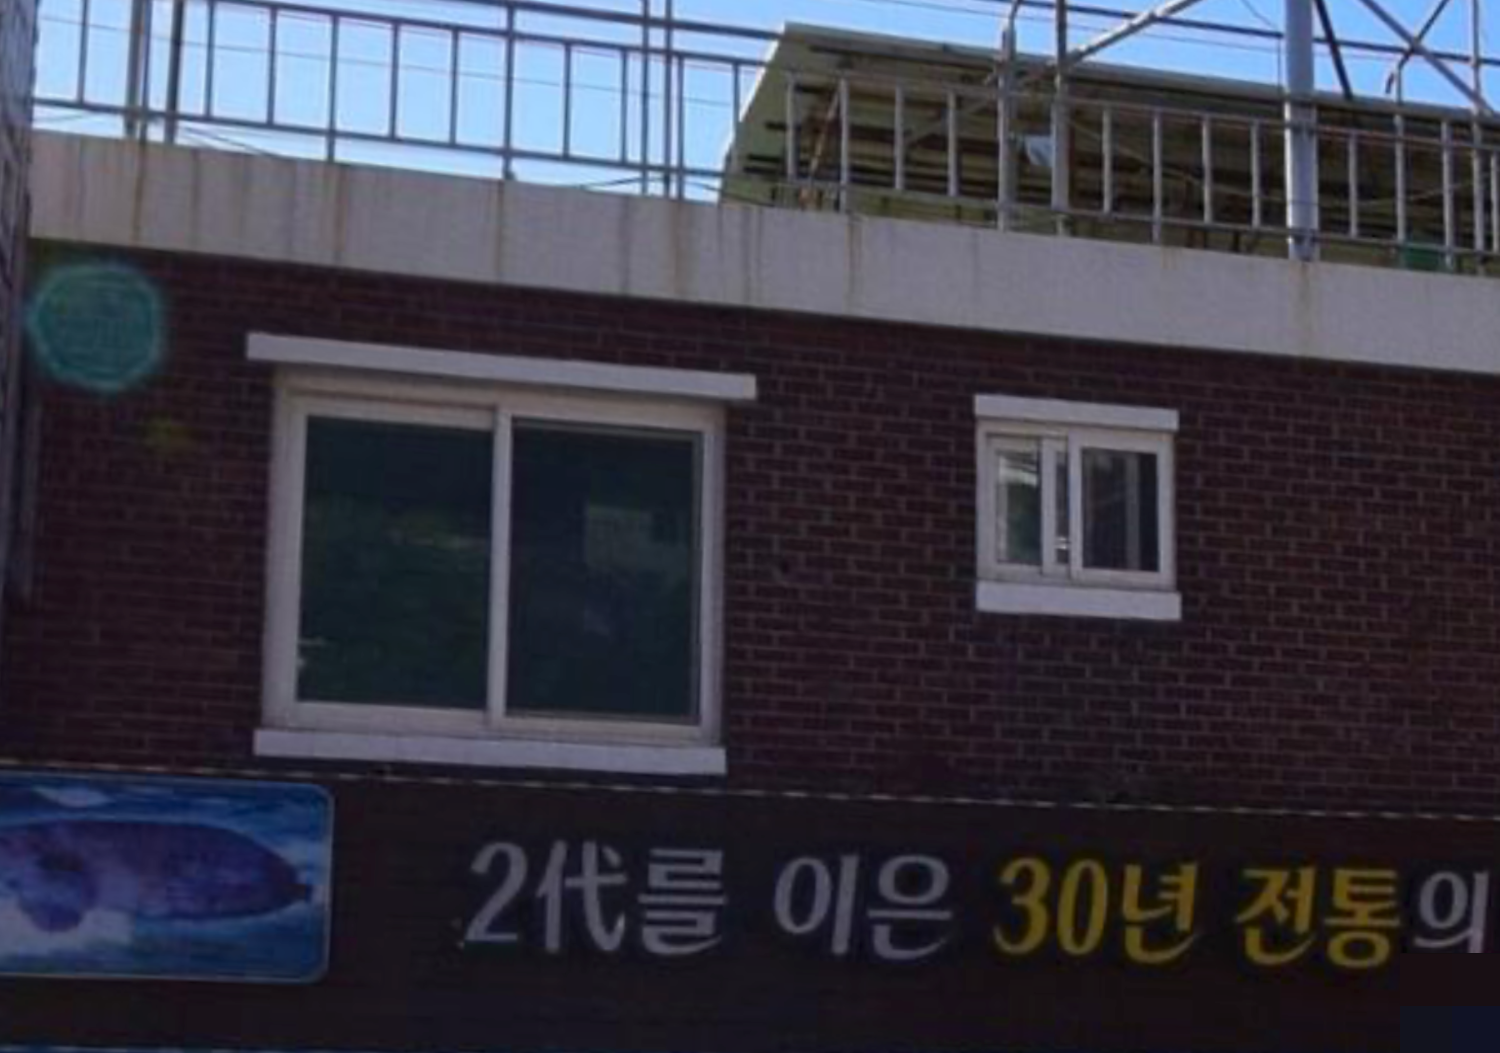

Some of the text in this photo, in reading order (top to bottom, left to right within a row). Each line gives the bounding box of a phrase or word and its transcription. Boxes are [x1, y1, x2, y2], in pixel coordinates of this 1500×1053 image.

[463, 838, 728, 957] 2代를
[773, 851, 953, 961] 이은
[992, 855, 1202, 966] 30년
[1233, 863, 1490, 970] 전통의
